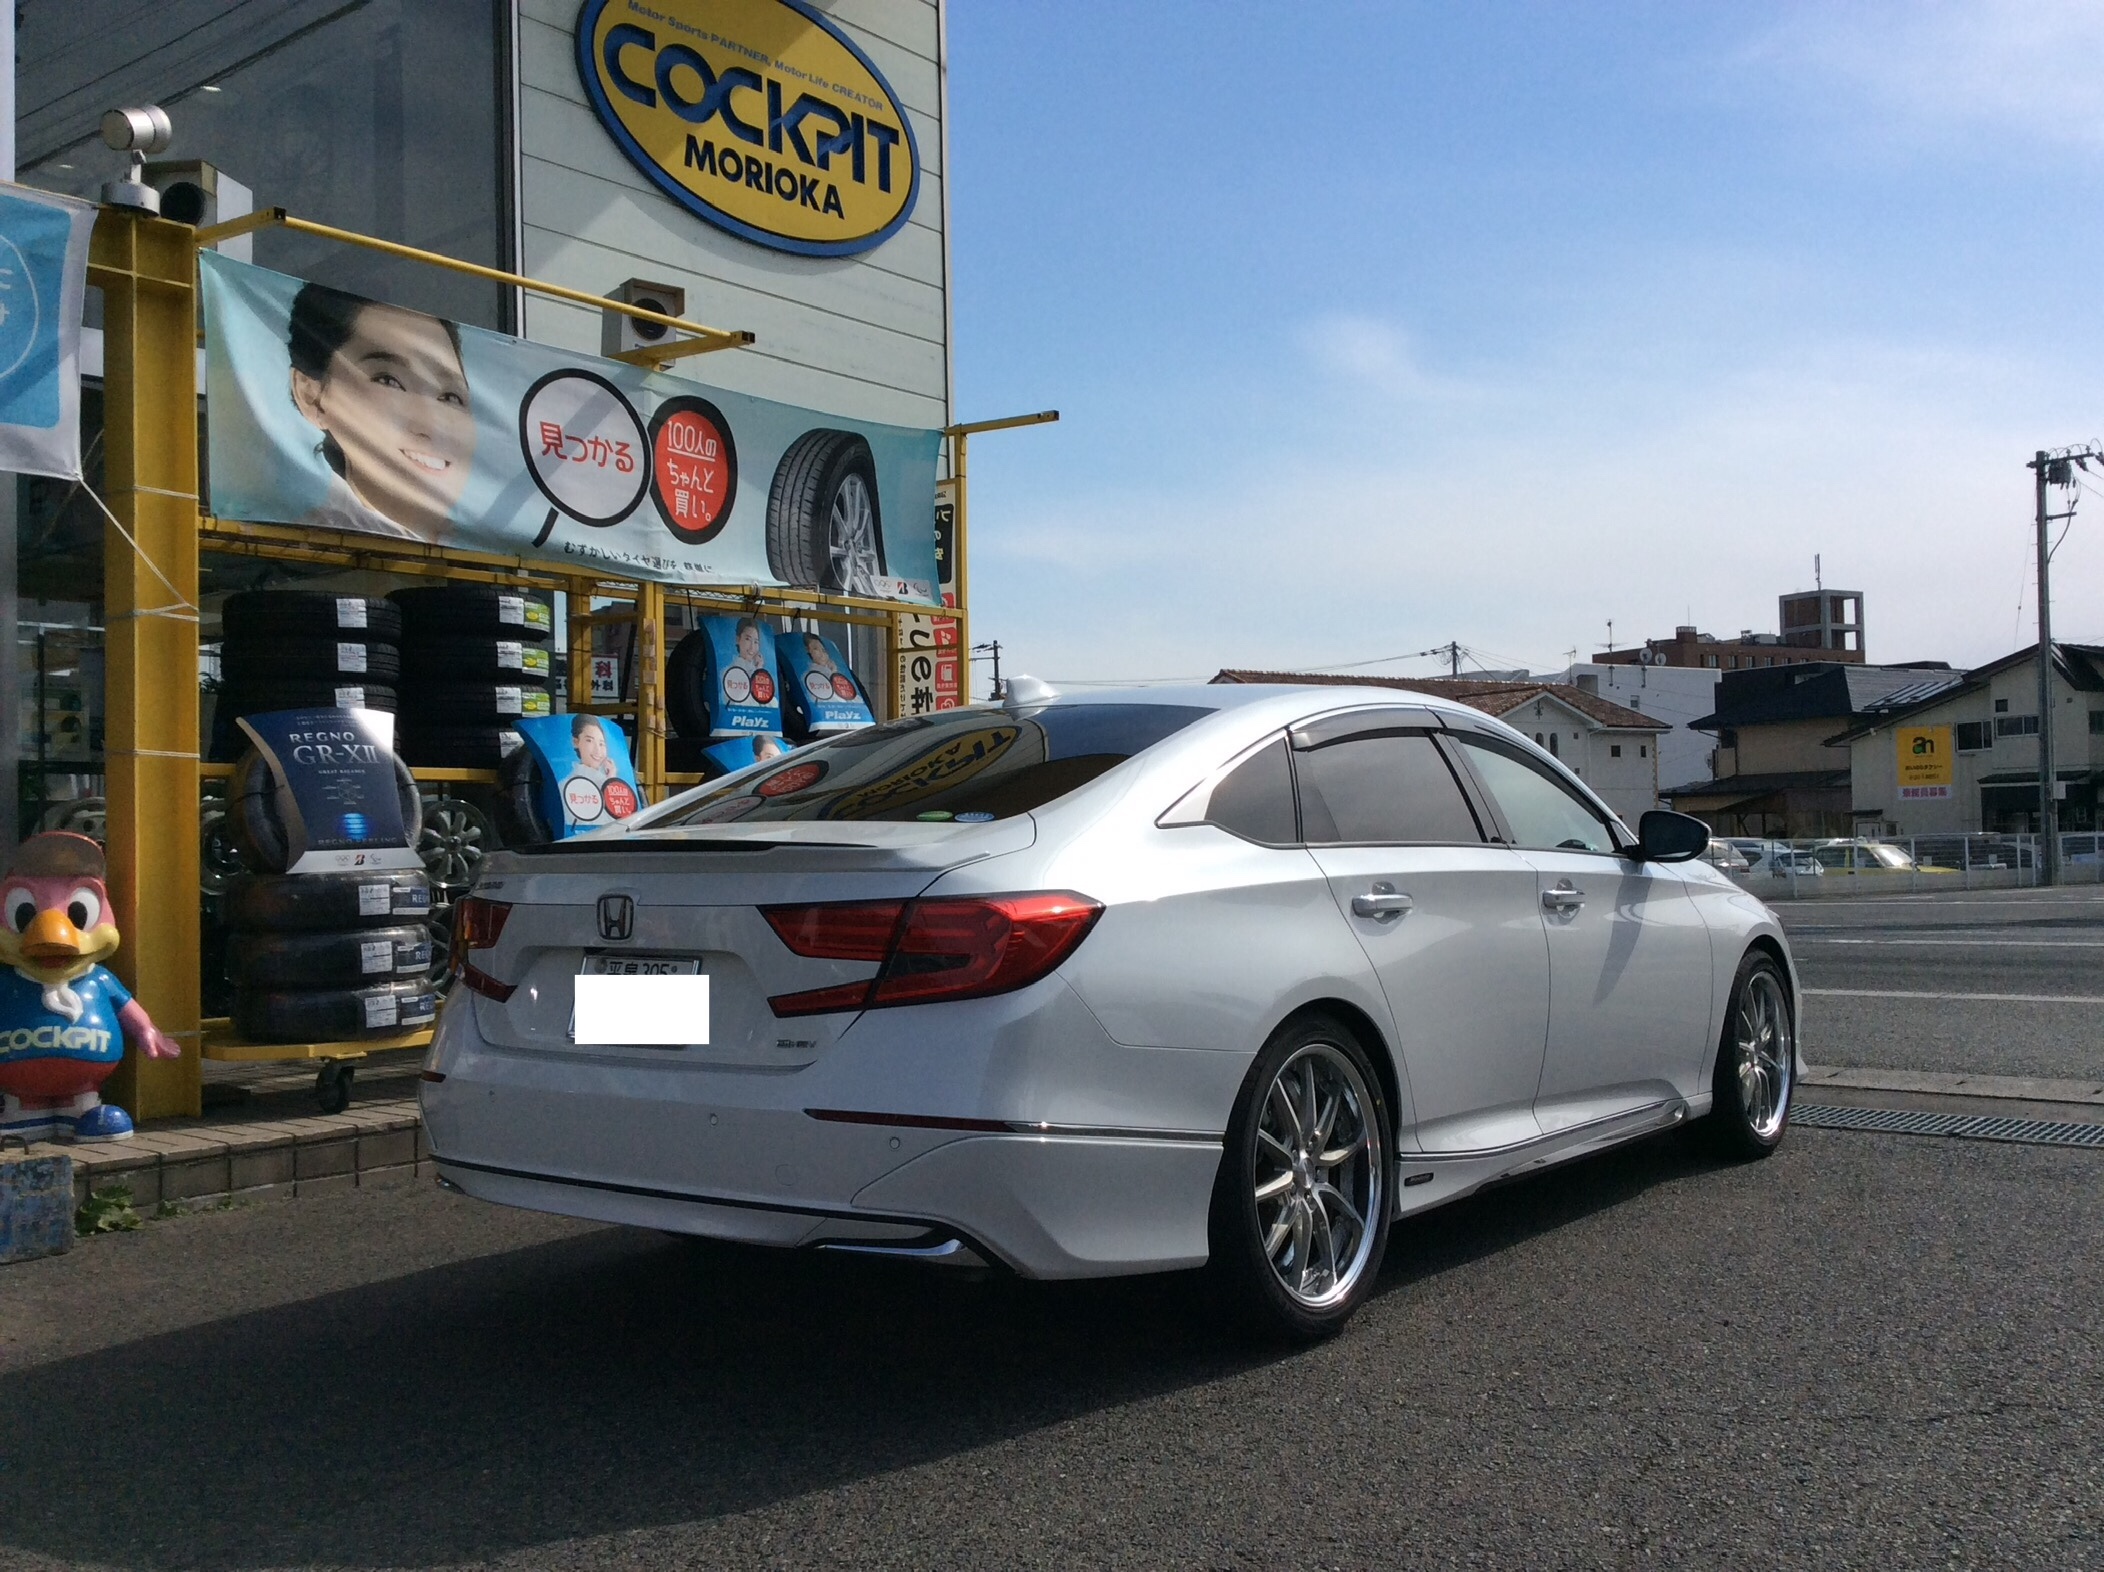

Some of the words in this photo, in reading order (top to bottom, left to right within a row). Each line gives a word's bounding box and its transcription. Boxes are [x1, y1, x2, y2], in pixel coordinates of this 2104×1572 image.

[627, 0, 666, 21] Motor
[668, 16, 709, 40] Sports
[774, 60, 808, 79] Motor
[808, 73, 830, 89] Life
[832, 83, 884, 111] CREATOR
[603, 22, 900, 194] COCKPIT
[684, 134, 846, 221] MORIOKA
[539, 421, 635, 473] 見つかる
[667, 420, 717, 457] 100人の
[667, 458, 714, 494] ちゃんと
[675, 488, 712, 522] 買い。
[289, 731, 355, 744] REGNO
[1912, 736, 1935, 754] an
[569, 793, 599, 805] 見つかる
[0, 1026, 111, 1053] COCKPIT
